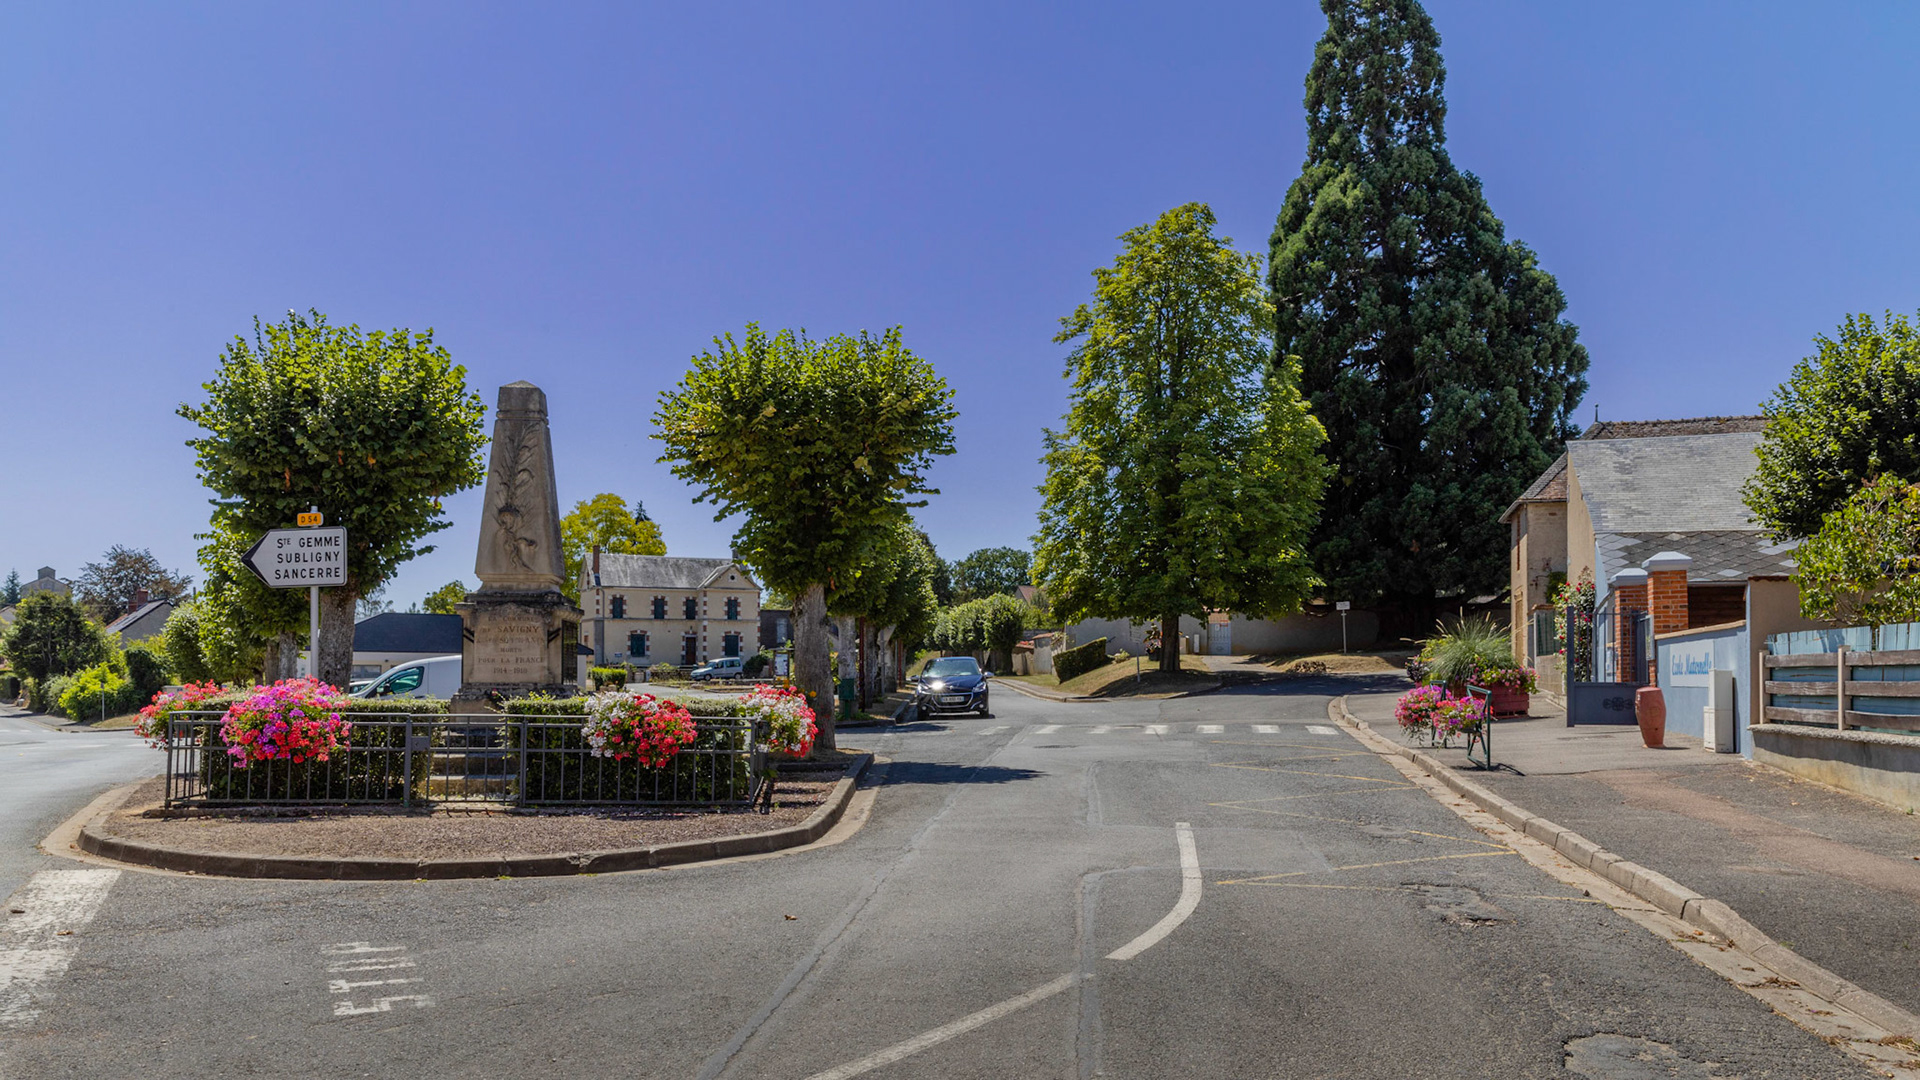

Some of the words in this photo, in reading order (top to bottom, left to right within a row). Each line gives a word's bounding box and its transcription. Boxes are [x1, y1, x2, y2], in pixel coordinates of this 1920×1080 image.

[308, 515, 318, 523] 54
[299, 536, 340, 548] GEMME
[277, 551, 340, 564] SUBLIGNY
[275, 567, 340, 580] SANCERRE
[497, 625, 540, 633] SAVIGNY
[515, 656, 545, 664] FRANCE
